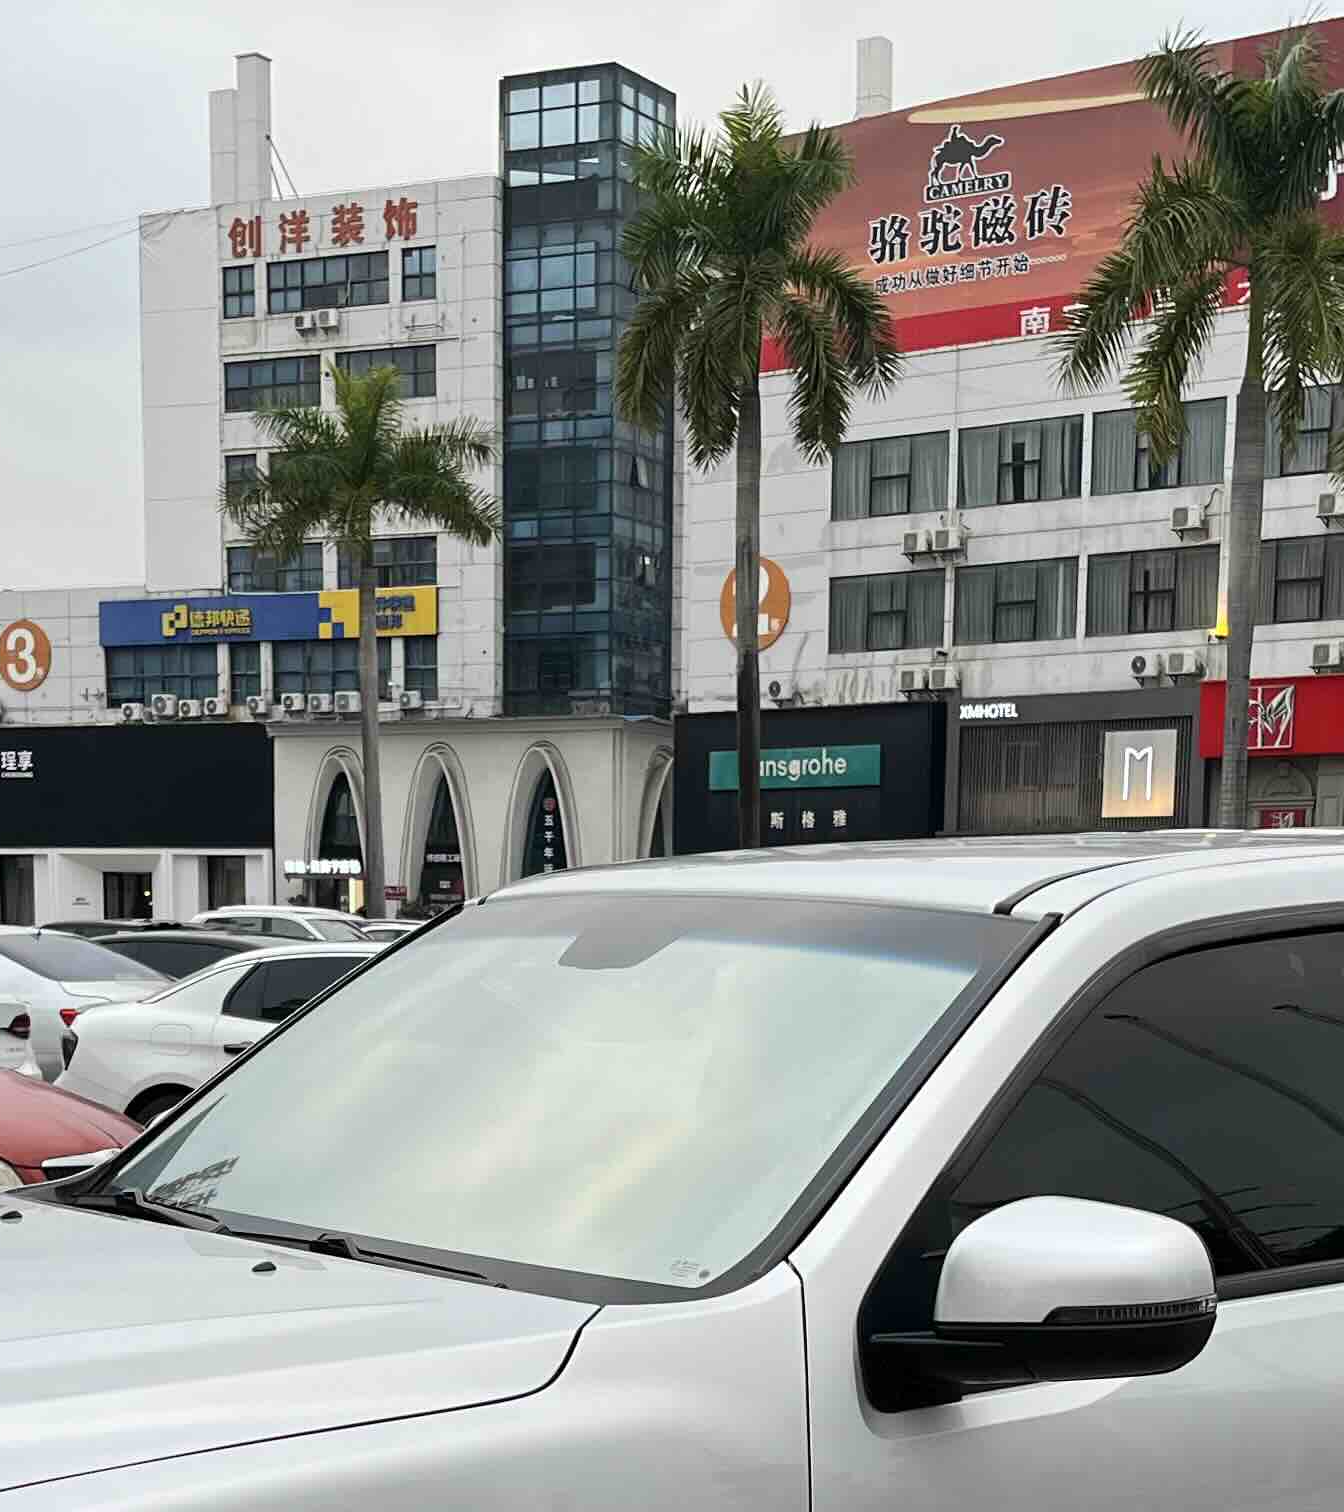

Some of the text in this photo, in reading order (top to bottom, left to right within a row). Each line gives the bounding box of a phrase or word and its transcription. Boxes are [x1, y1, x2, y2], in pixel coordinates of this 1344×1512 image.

[929, 175, 1006, 200] CAMELRY
[228, 197, 417, 257] 创洋装饰
[868, 185, 1072, 264] 骆驼磁砖
[759, 746, 848, 782] nsgrohe
[769, 809, 848, 830] 斯格雅
